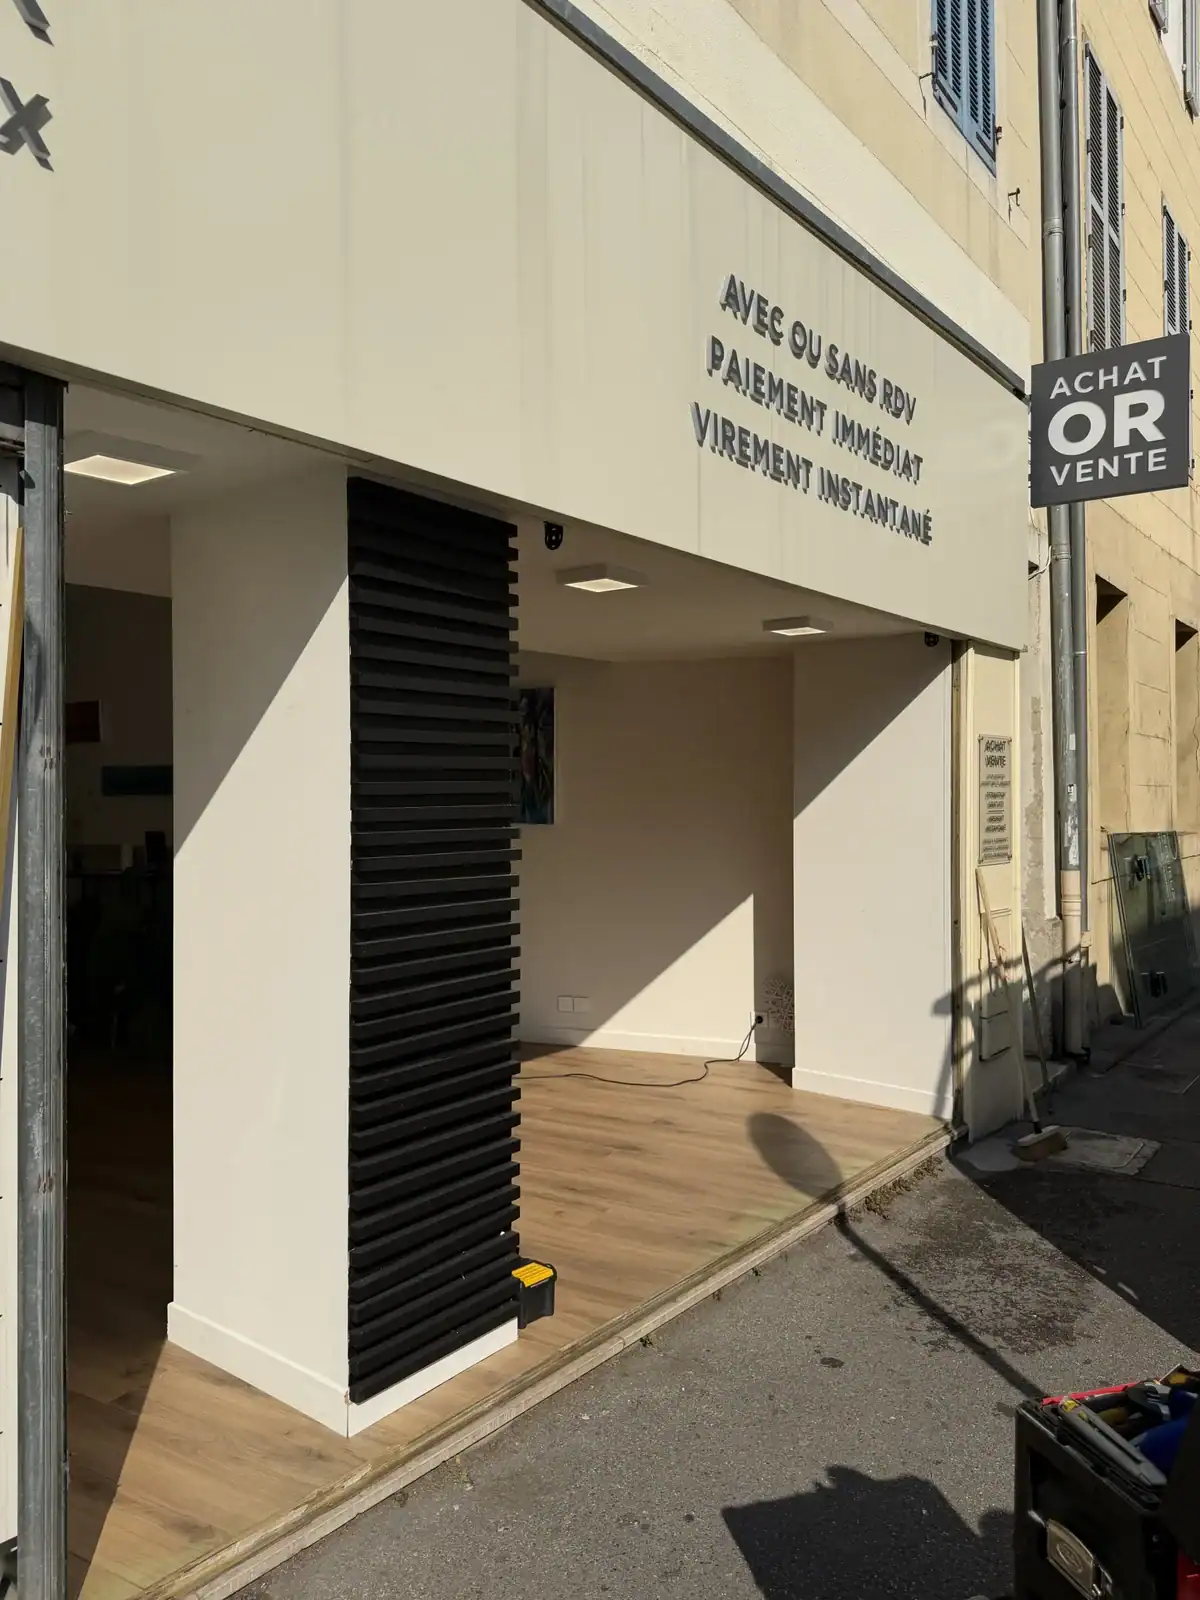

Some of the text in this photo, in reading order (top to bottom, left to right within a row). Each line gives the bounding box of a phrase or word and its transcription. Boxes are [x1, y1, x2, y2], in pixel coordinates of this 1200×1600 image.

[719, 273, 917, 425] AVEC OU SANS RDV
[1049, 355, 1167, 399] ACHAT
[706, 334, 923, 485] PAIEMENT IMMÉDIAT
[1047, 389, 1166, 456] OR
[690, 401, 933, 546] VIREMENT INSTANTANÉ
[1050, 447, 1167, 486] VENTE
[984, 740, 1006, 752] ACHAT
[985, 755, 1006, 768] VENTE
